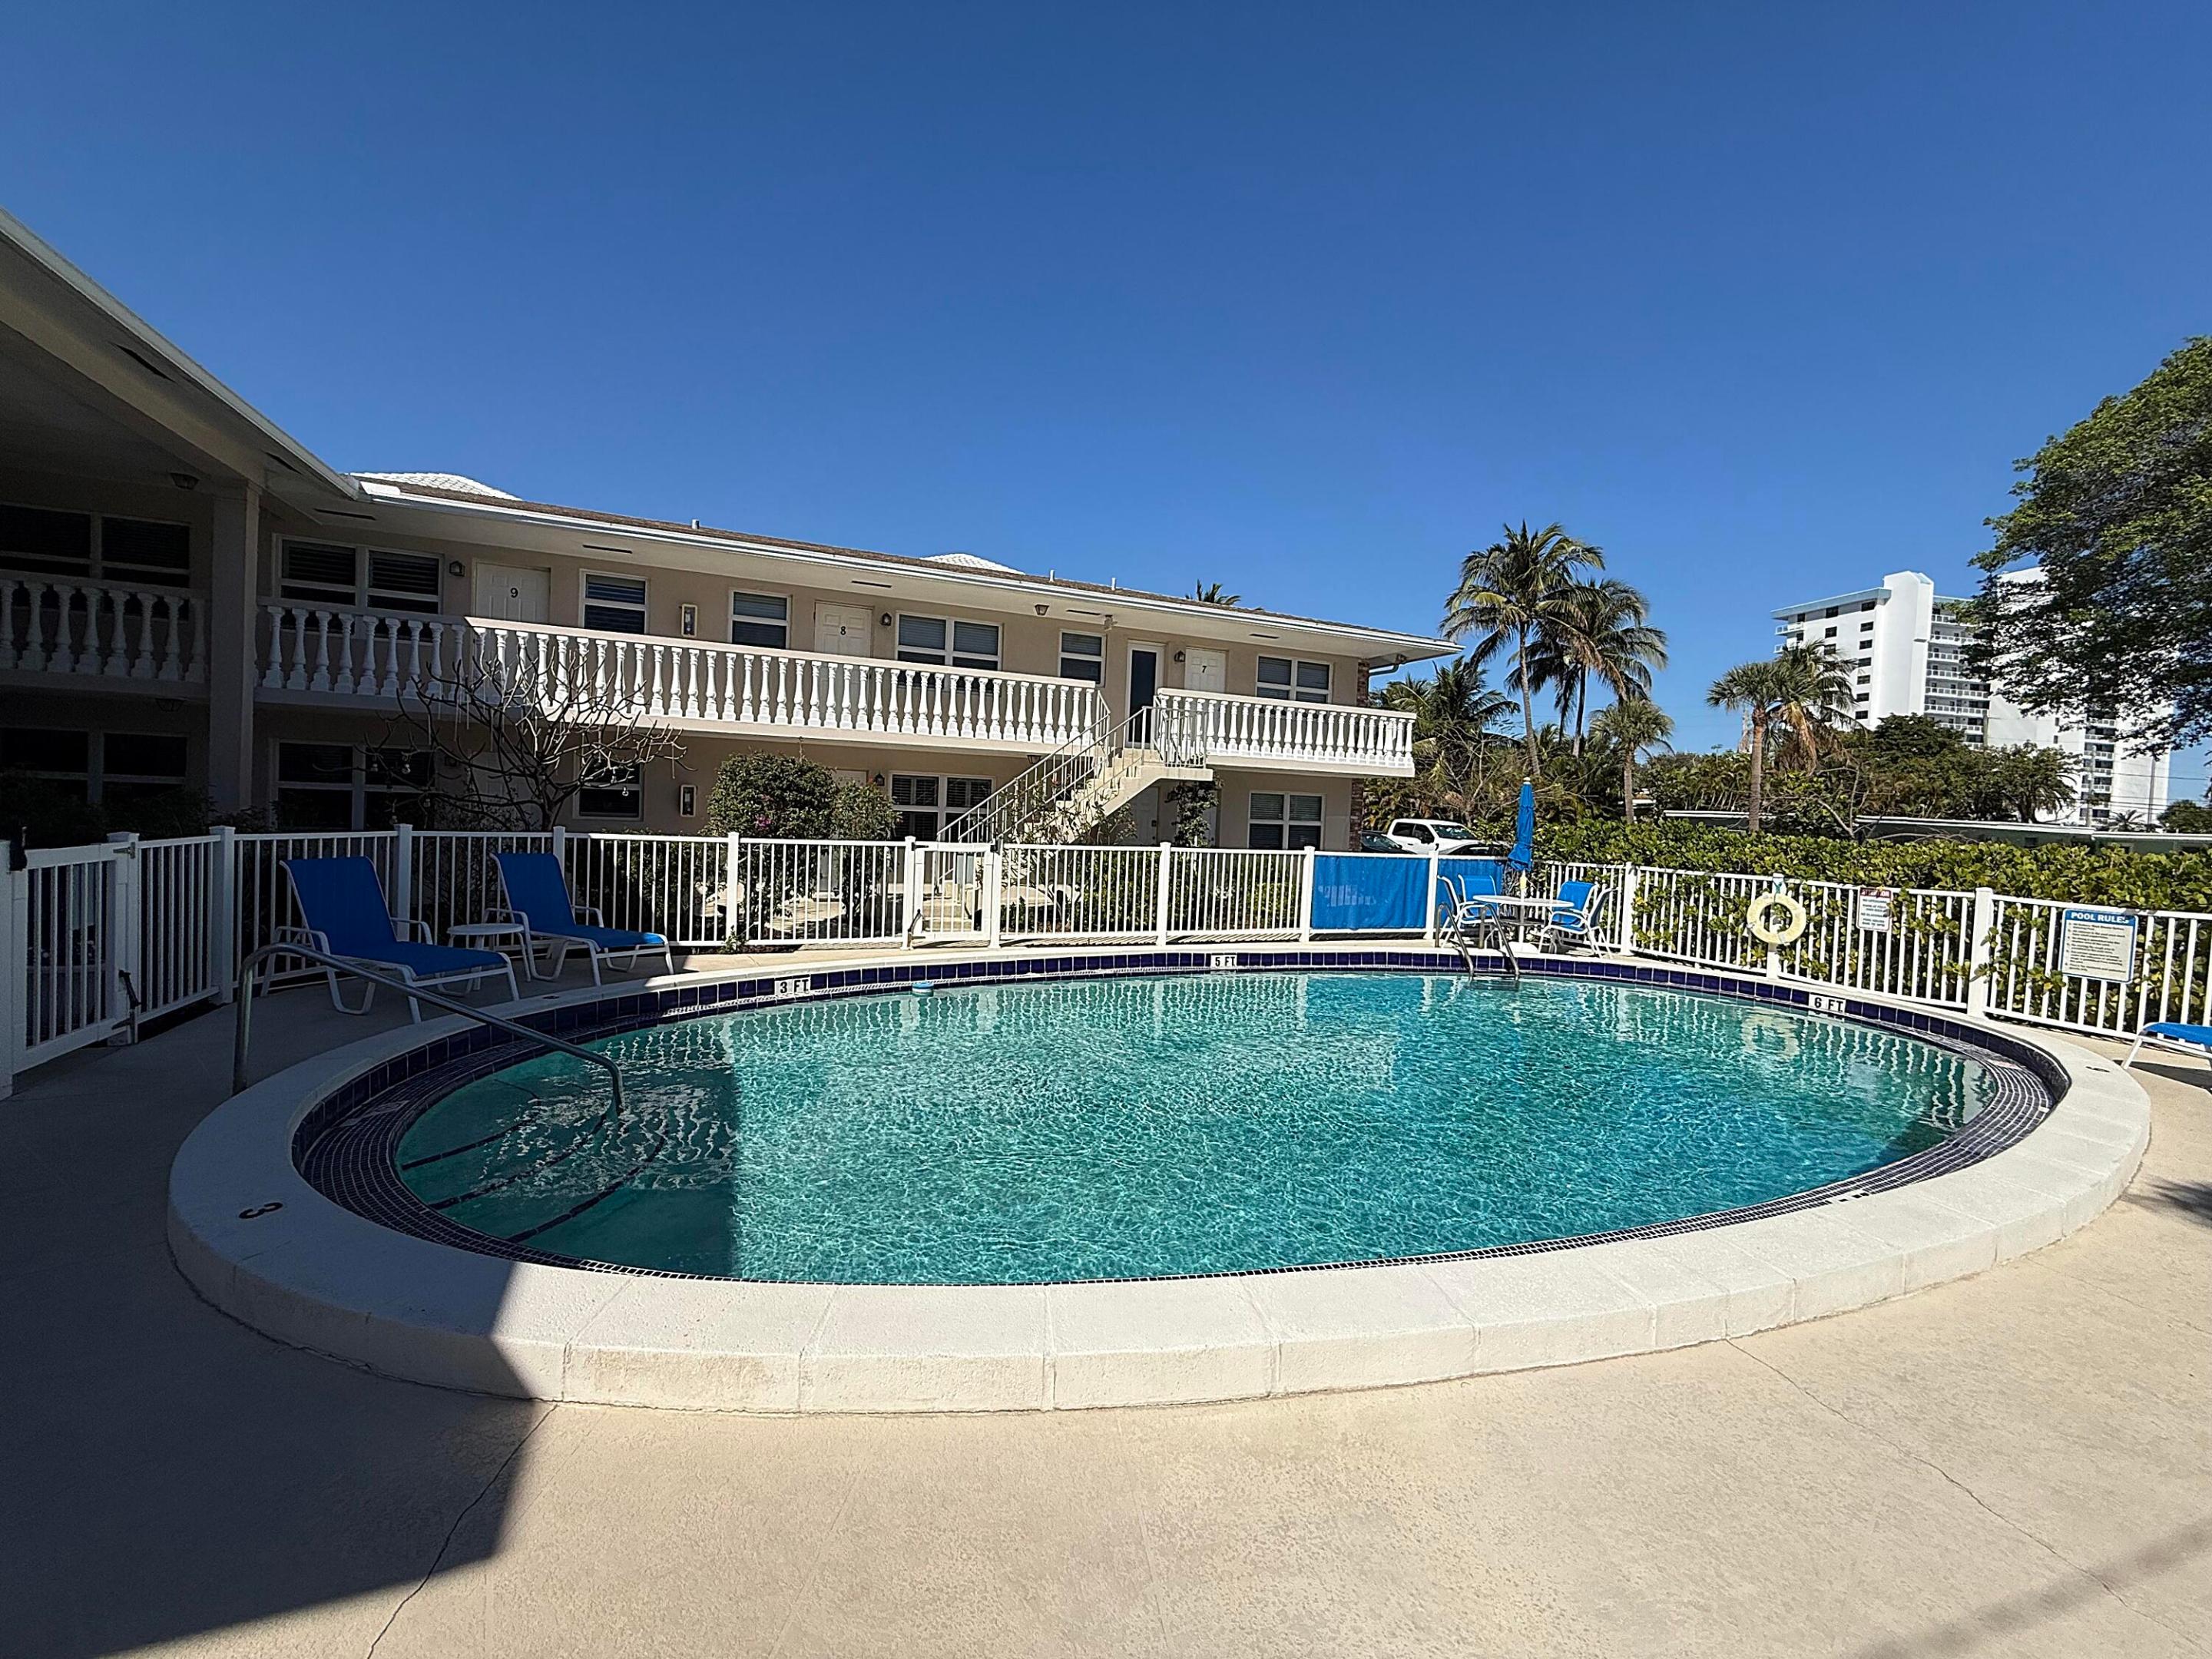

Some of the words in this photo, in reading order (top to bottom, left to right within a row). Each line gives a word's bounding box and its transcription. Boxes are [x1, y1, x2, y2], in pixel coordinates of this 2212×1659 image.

[510, 587, 518, 598] 9
[839, 626, 846, 635] 8
[2071, 912, 2096, 921] POOL
[1215, 956, 1220, 967] 5
[780, 981, 788, 994] 3
[1814, 997, 1823, 1008] 6
[238, 1202, 283, 1220] 3
